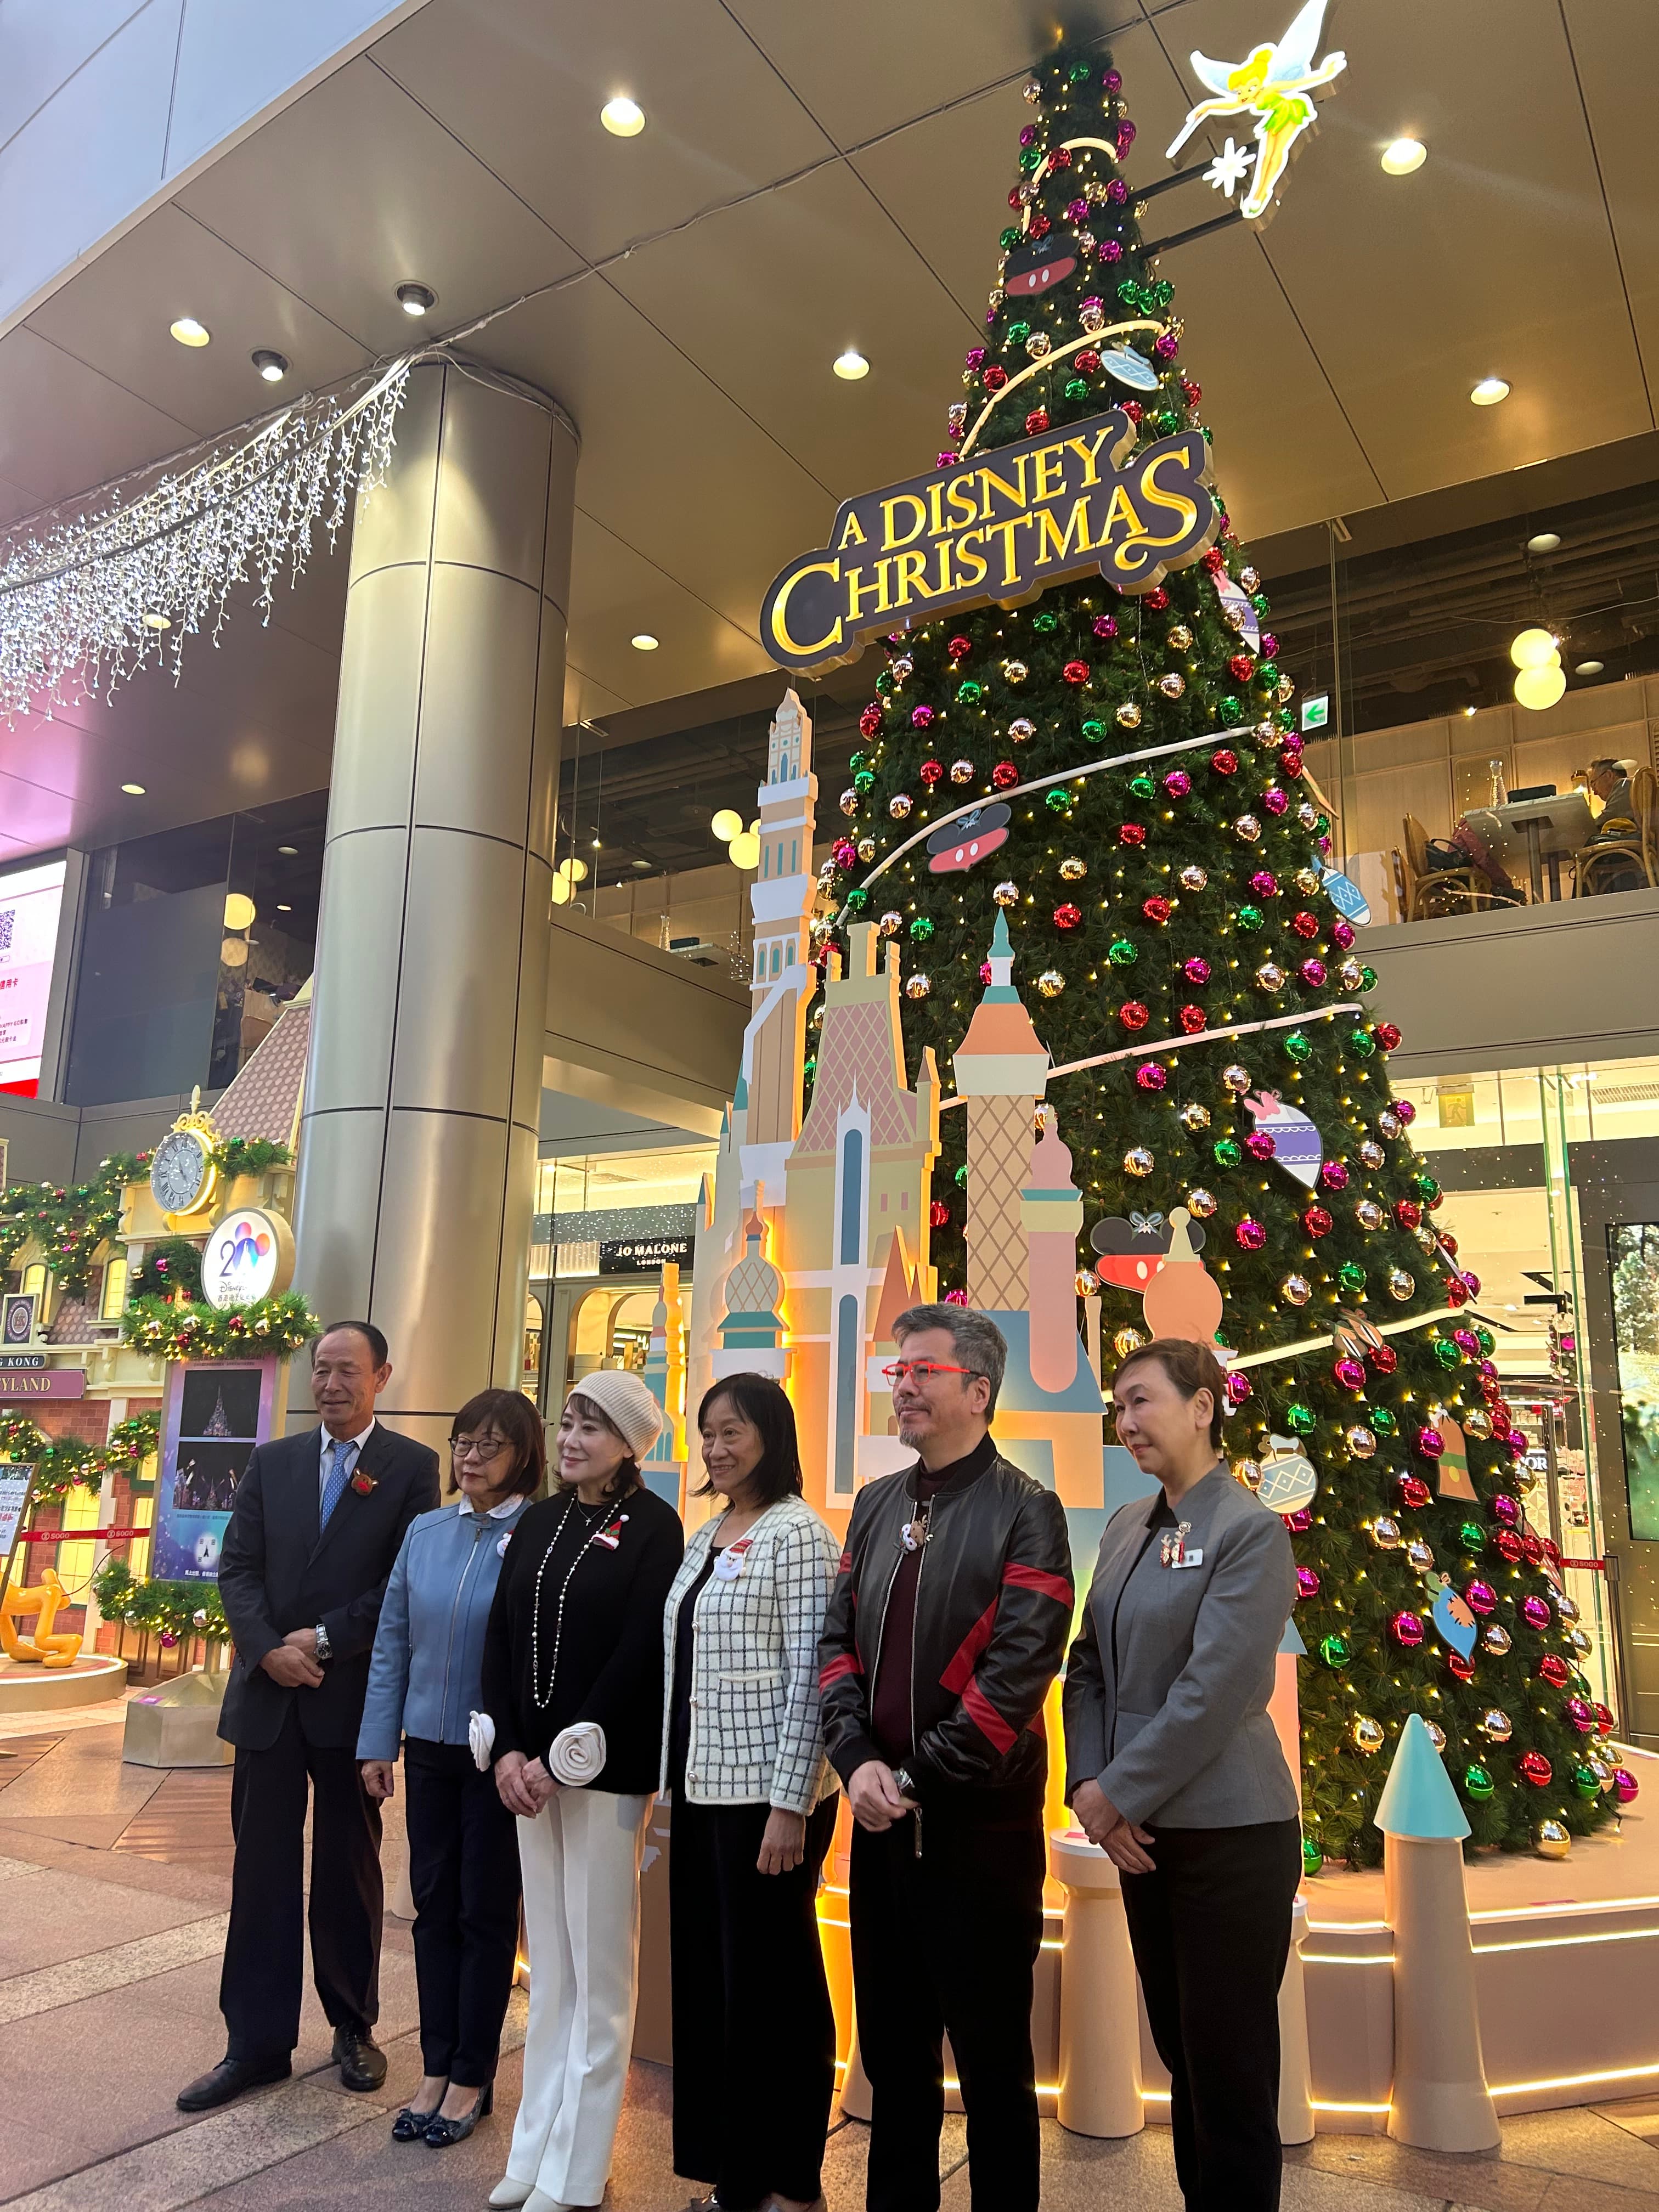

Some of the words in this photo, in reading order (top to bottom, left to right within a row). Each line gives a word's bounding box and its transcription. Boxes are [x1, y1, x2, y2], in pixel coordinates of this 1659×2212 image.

[838, 511, 867, 551] A
[879, 425, 1115, 552] DISNEY
[771, 446, 1198, 656] CHRISTMAS
[616, 1246, 632, 1257] JO
[634, 1243, 687, 1256] MALONE
[8, 1357, 39, 1367] KONG
[0, 1377, 51, 1392] YLAND
